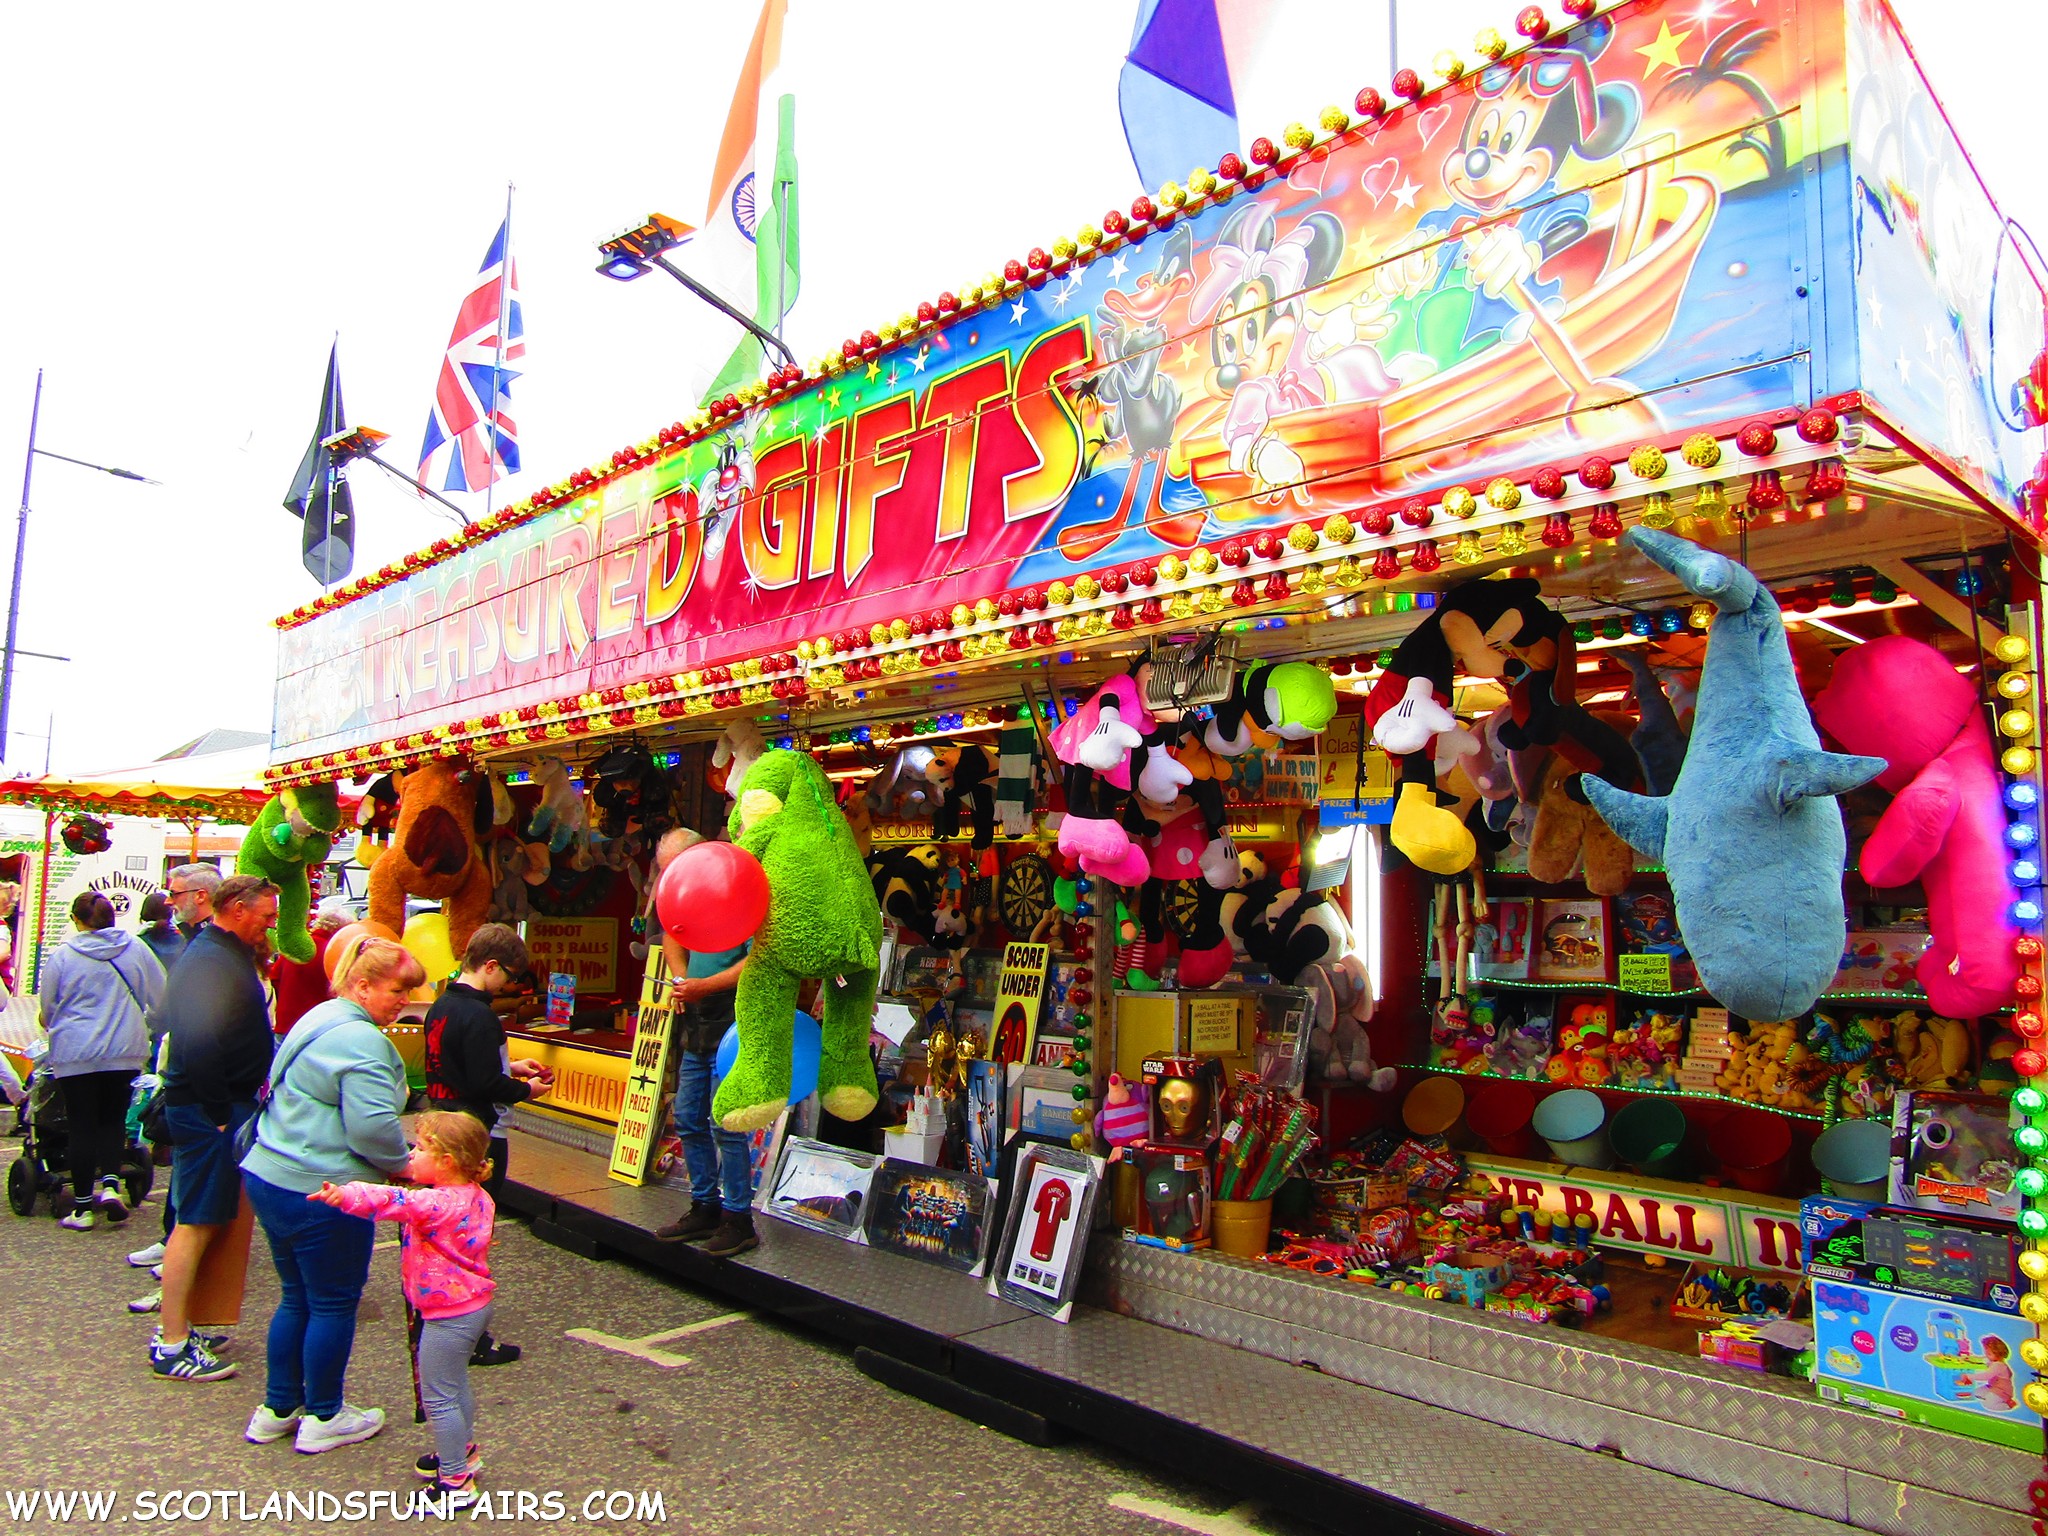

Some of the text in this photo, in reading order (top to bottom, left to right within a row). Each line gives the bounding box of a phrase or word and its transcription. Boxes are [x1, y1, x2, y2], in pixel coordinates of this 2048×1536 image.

[355, 314, 1092, 712] TREASURED GIFTS
[1300, 760, 1316, 777] BUY
[1301, 783, 1318, 800] TRY
[1323, 799, 1352, 808] PRIZE
[1343, 811, 1368, 820] TIME
[88, 876, 112, 892] ACK
[534, 924, 583, 937] SHOOT
[532, 941, 610, 954] OR 3 BALLS
[1006, 945, 1045, 970] SCORE
[580, 960, 608, 982] WIN
[1001, 973, 1041, 998] UNDER
[640, 1006, 668, 1038] CAN'T
[635, 1038, 662, 1071] LOSE
[1143, 1066, 1164, 1074] WARS
[555, 1067, 584, 1105] LAST
[629, 1093, 651, 1114] PRIZE
[622, 1118, 648, 1141] EVERY
[620, 1145, 639, 1167] TIME
[1047, 1187, 1065, 1198] ANFIELD
[1918, 1178, 1990, 1203] DINOSAUR
[1560, 1186, 1714, 1256] BALL
[1869, 1281, 1953, 1301] AUTO TRANSPORTER
